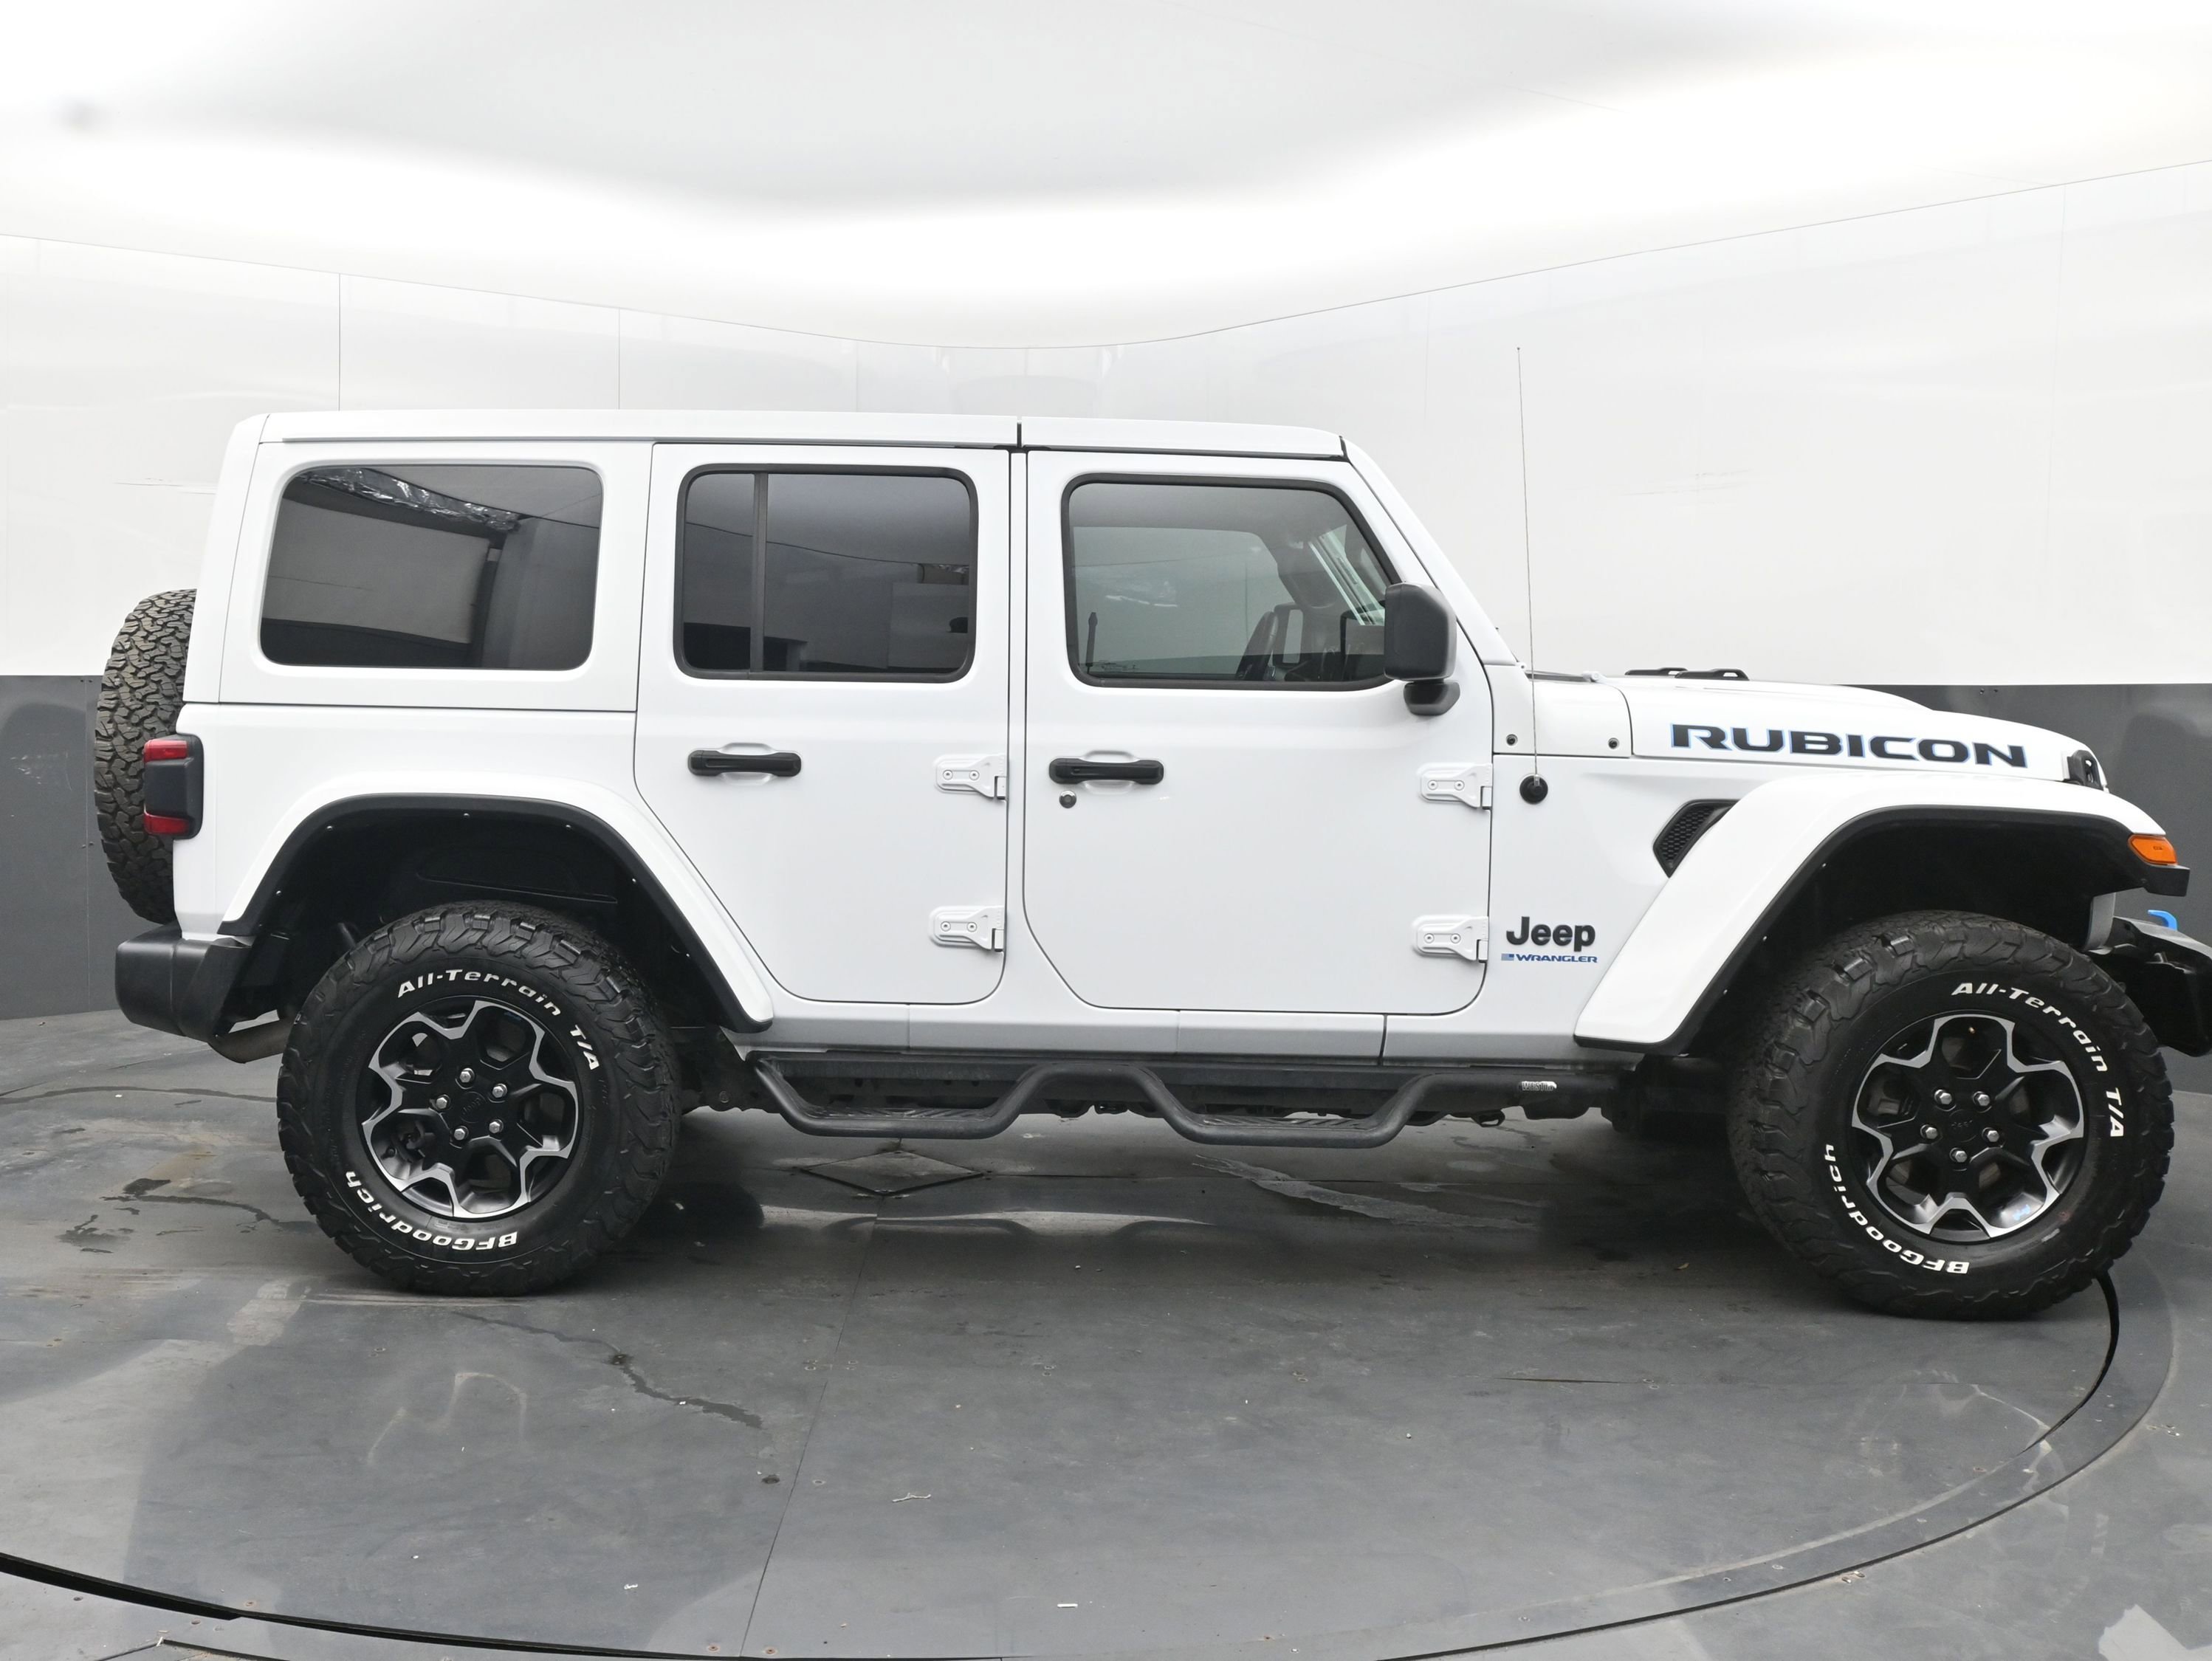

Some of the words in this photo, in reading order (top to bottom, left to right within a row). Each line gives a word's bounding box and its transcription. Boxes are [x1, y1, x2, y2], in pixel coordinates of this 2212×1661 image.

[1669, 723, 2028, 769] RUBICON
[1505, 915, 1596, 952] Jeep
[1515, 953, 1598, 963] WRANGLER
[397, 969, 561, 1017] All-Terrain
[569, 1025, 600, 1071] T/A
[1951, 982, 2109, 1073] All-Terrain
[2105, 1087, 2125, 1138] T/A
[345, 1170, 518, 1251] BFGoodrich
[1824, 1144, 1971, 1275] BFGoodrich
